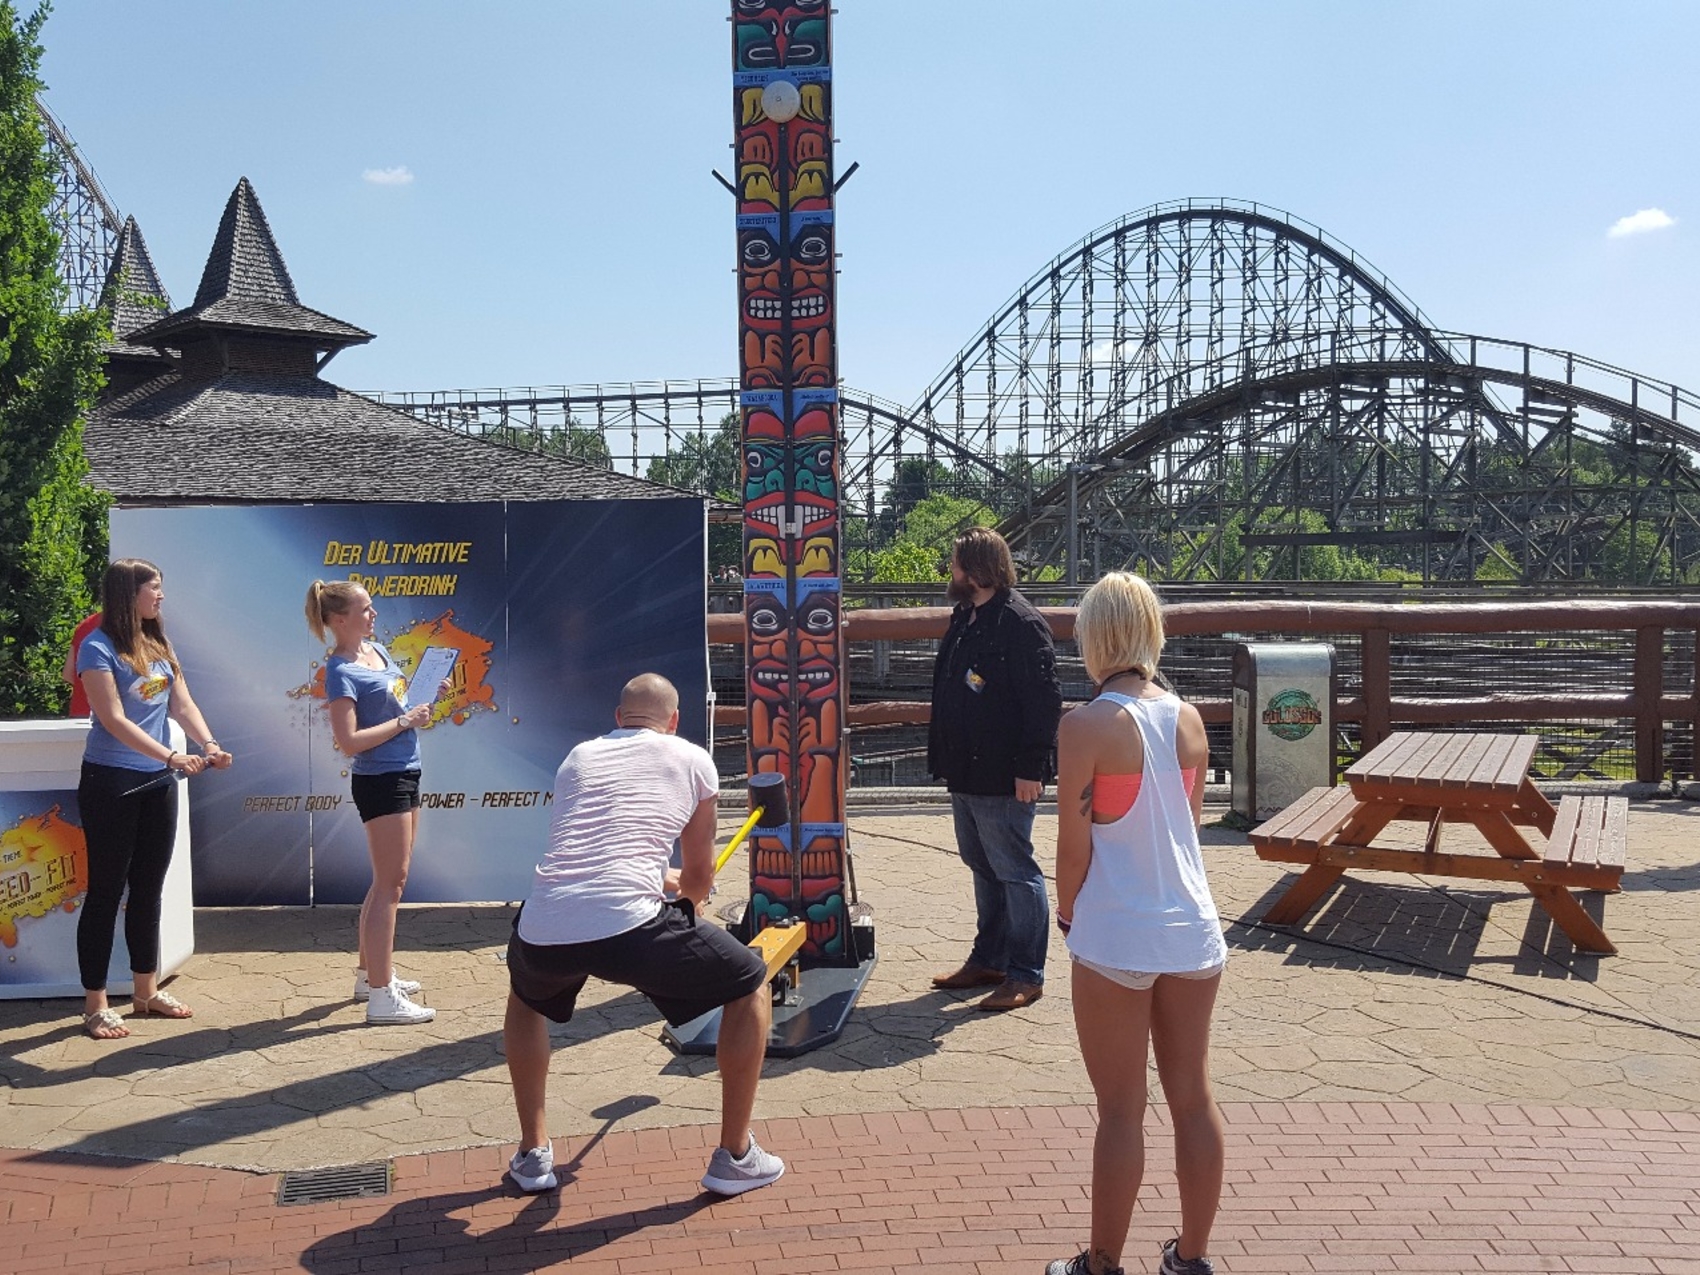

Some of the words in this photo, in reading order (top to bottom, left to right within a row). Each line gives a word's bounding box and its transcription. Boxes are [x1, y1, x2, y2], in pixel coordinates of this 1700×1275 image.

[324, 541, 363, 565] DER
[367, 540, 472, 564] ULTIMATIVE
[243, 796, 302, 812] PERFECT
[305, 795, 342, 811] BODY
[420, 793, 465, 809] POWER
[481, 792, 540, 807] PERFECT
